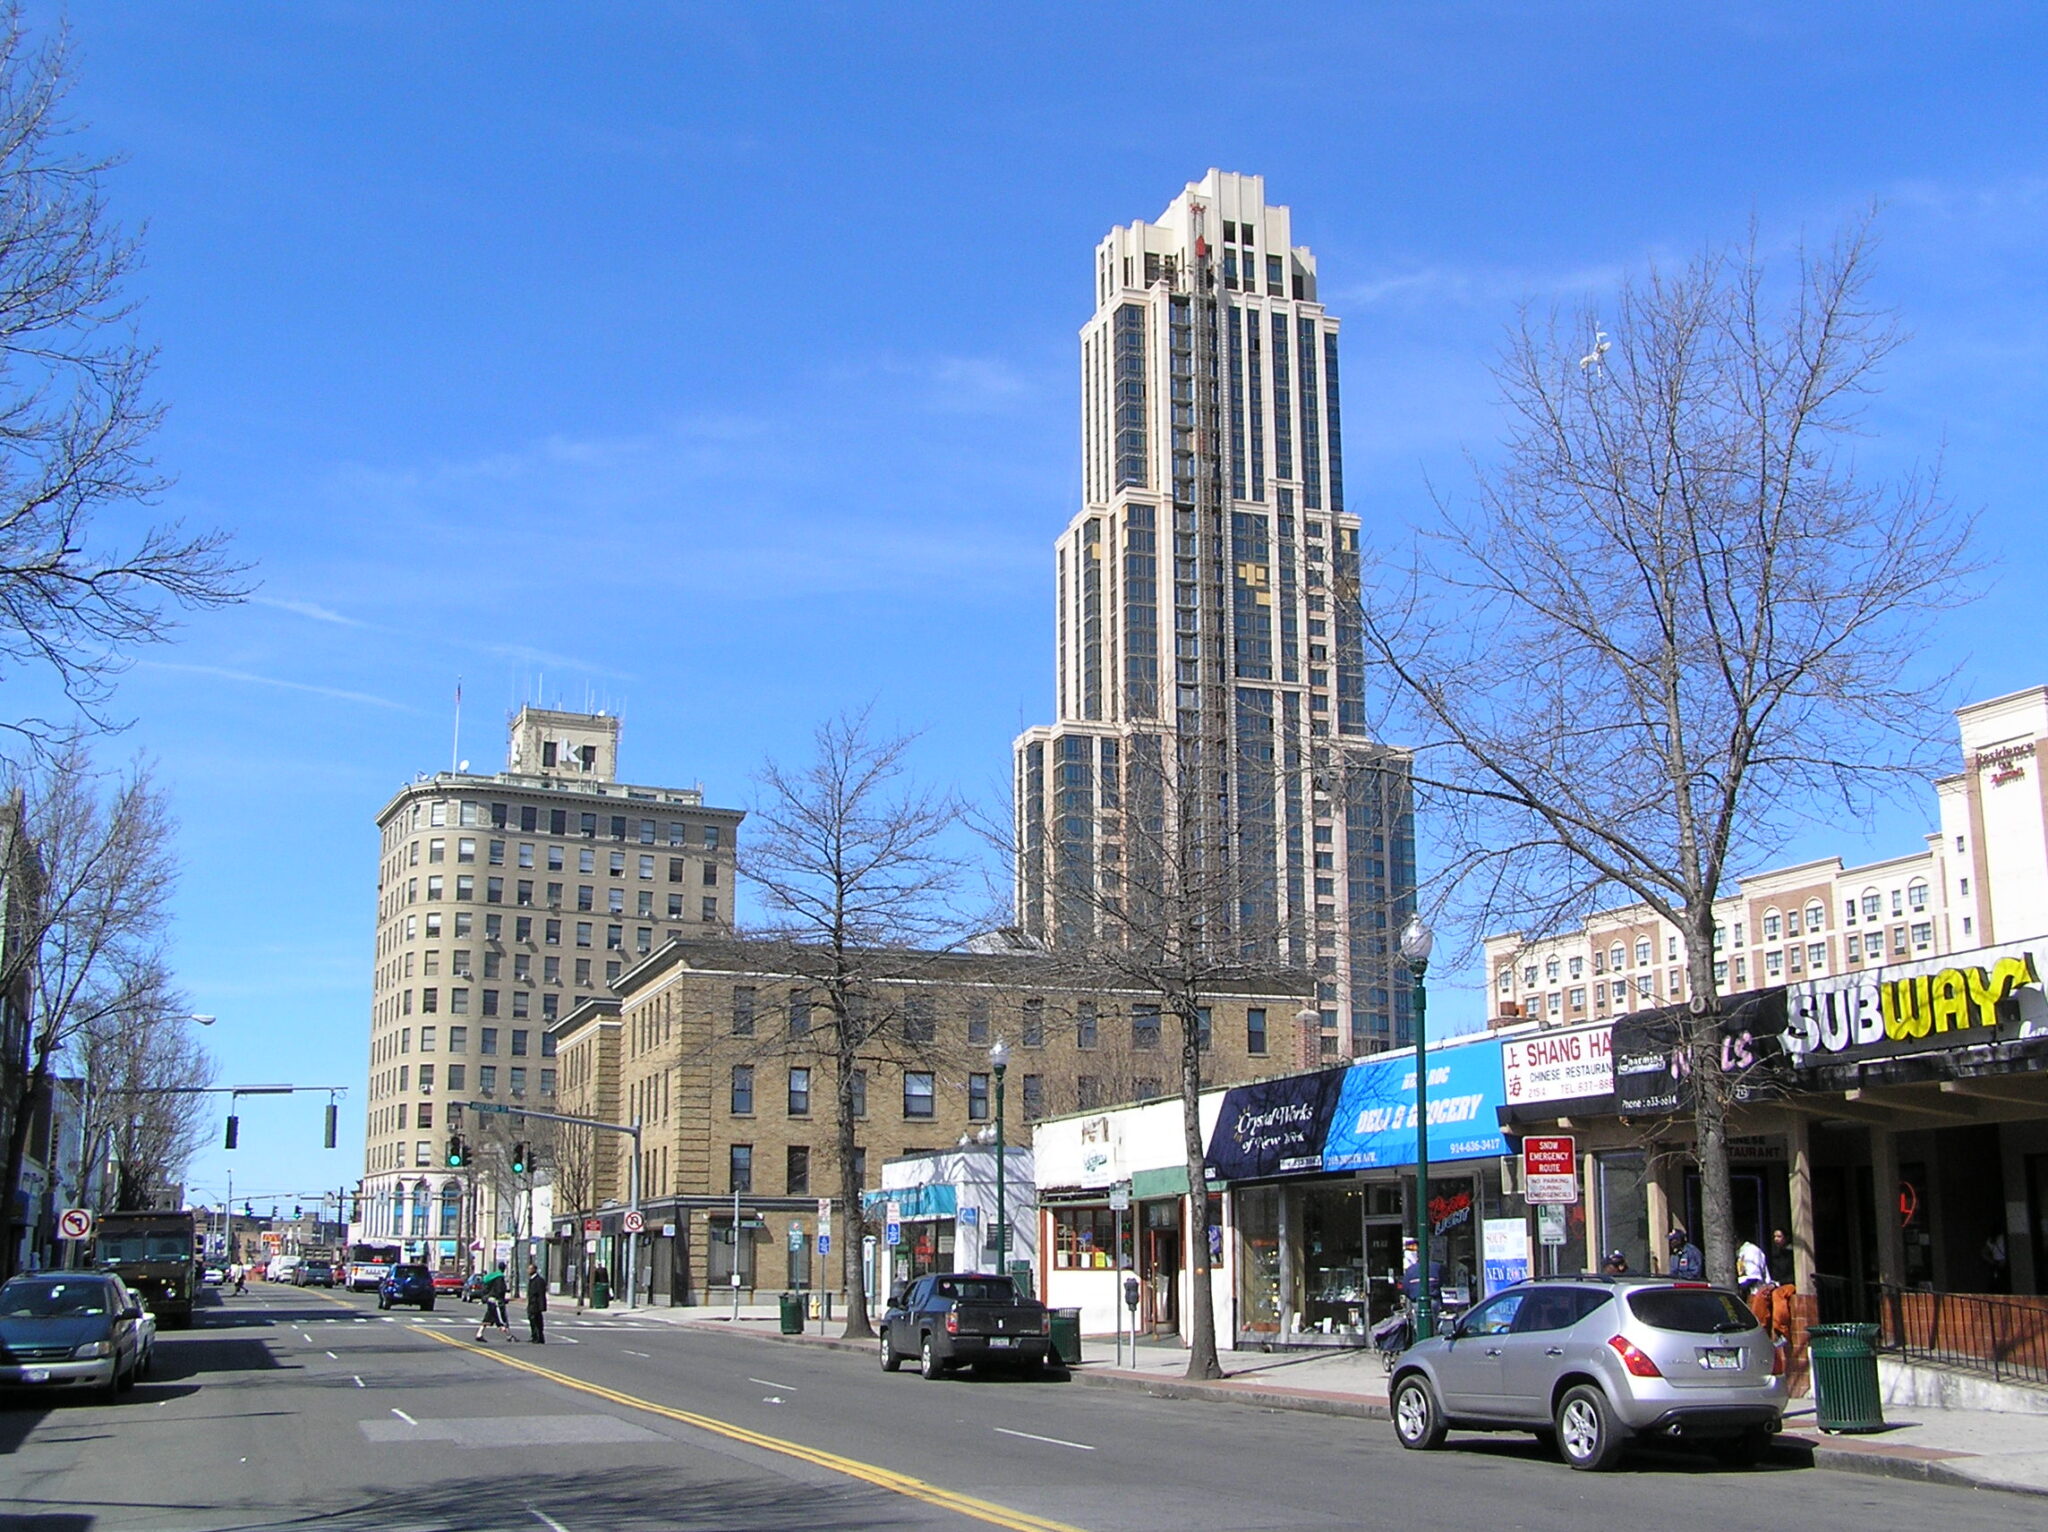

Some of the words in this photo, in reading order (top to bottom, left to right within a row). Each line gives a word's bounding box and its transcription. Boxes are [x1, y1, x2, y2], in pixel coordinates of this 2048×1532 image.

[1777, 952, 2038, 1056] SUBWAY
[1526, 1036, 1581, 1067] SHANG
[1671, 1030, 1753, 1080] NLS
[1401, 1070, 1427, 1090] NE
[1530, 1069, 1561, 1083] CHINESE
[1237, 1108, 1276, 1136] Crystal
[1275, 1103, 1314, 1126] Works
[1355, 1106, 1392, 1134] DELI
[1406, 1093, 1484, 1128] GOCERY
[1242, 1137, 1254, 1154] of
[1254, 1135, 1281, 1150] New
[1539, 1141, 1559, 1150] SNOW
[1529, 1152, 1570, 1161] EMERGENCY
[1538, 1163, 1561, 1172] ROUTE
